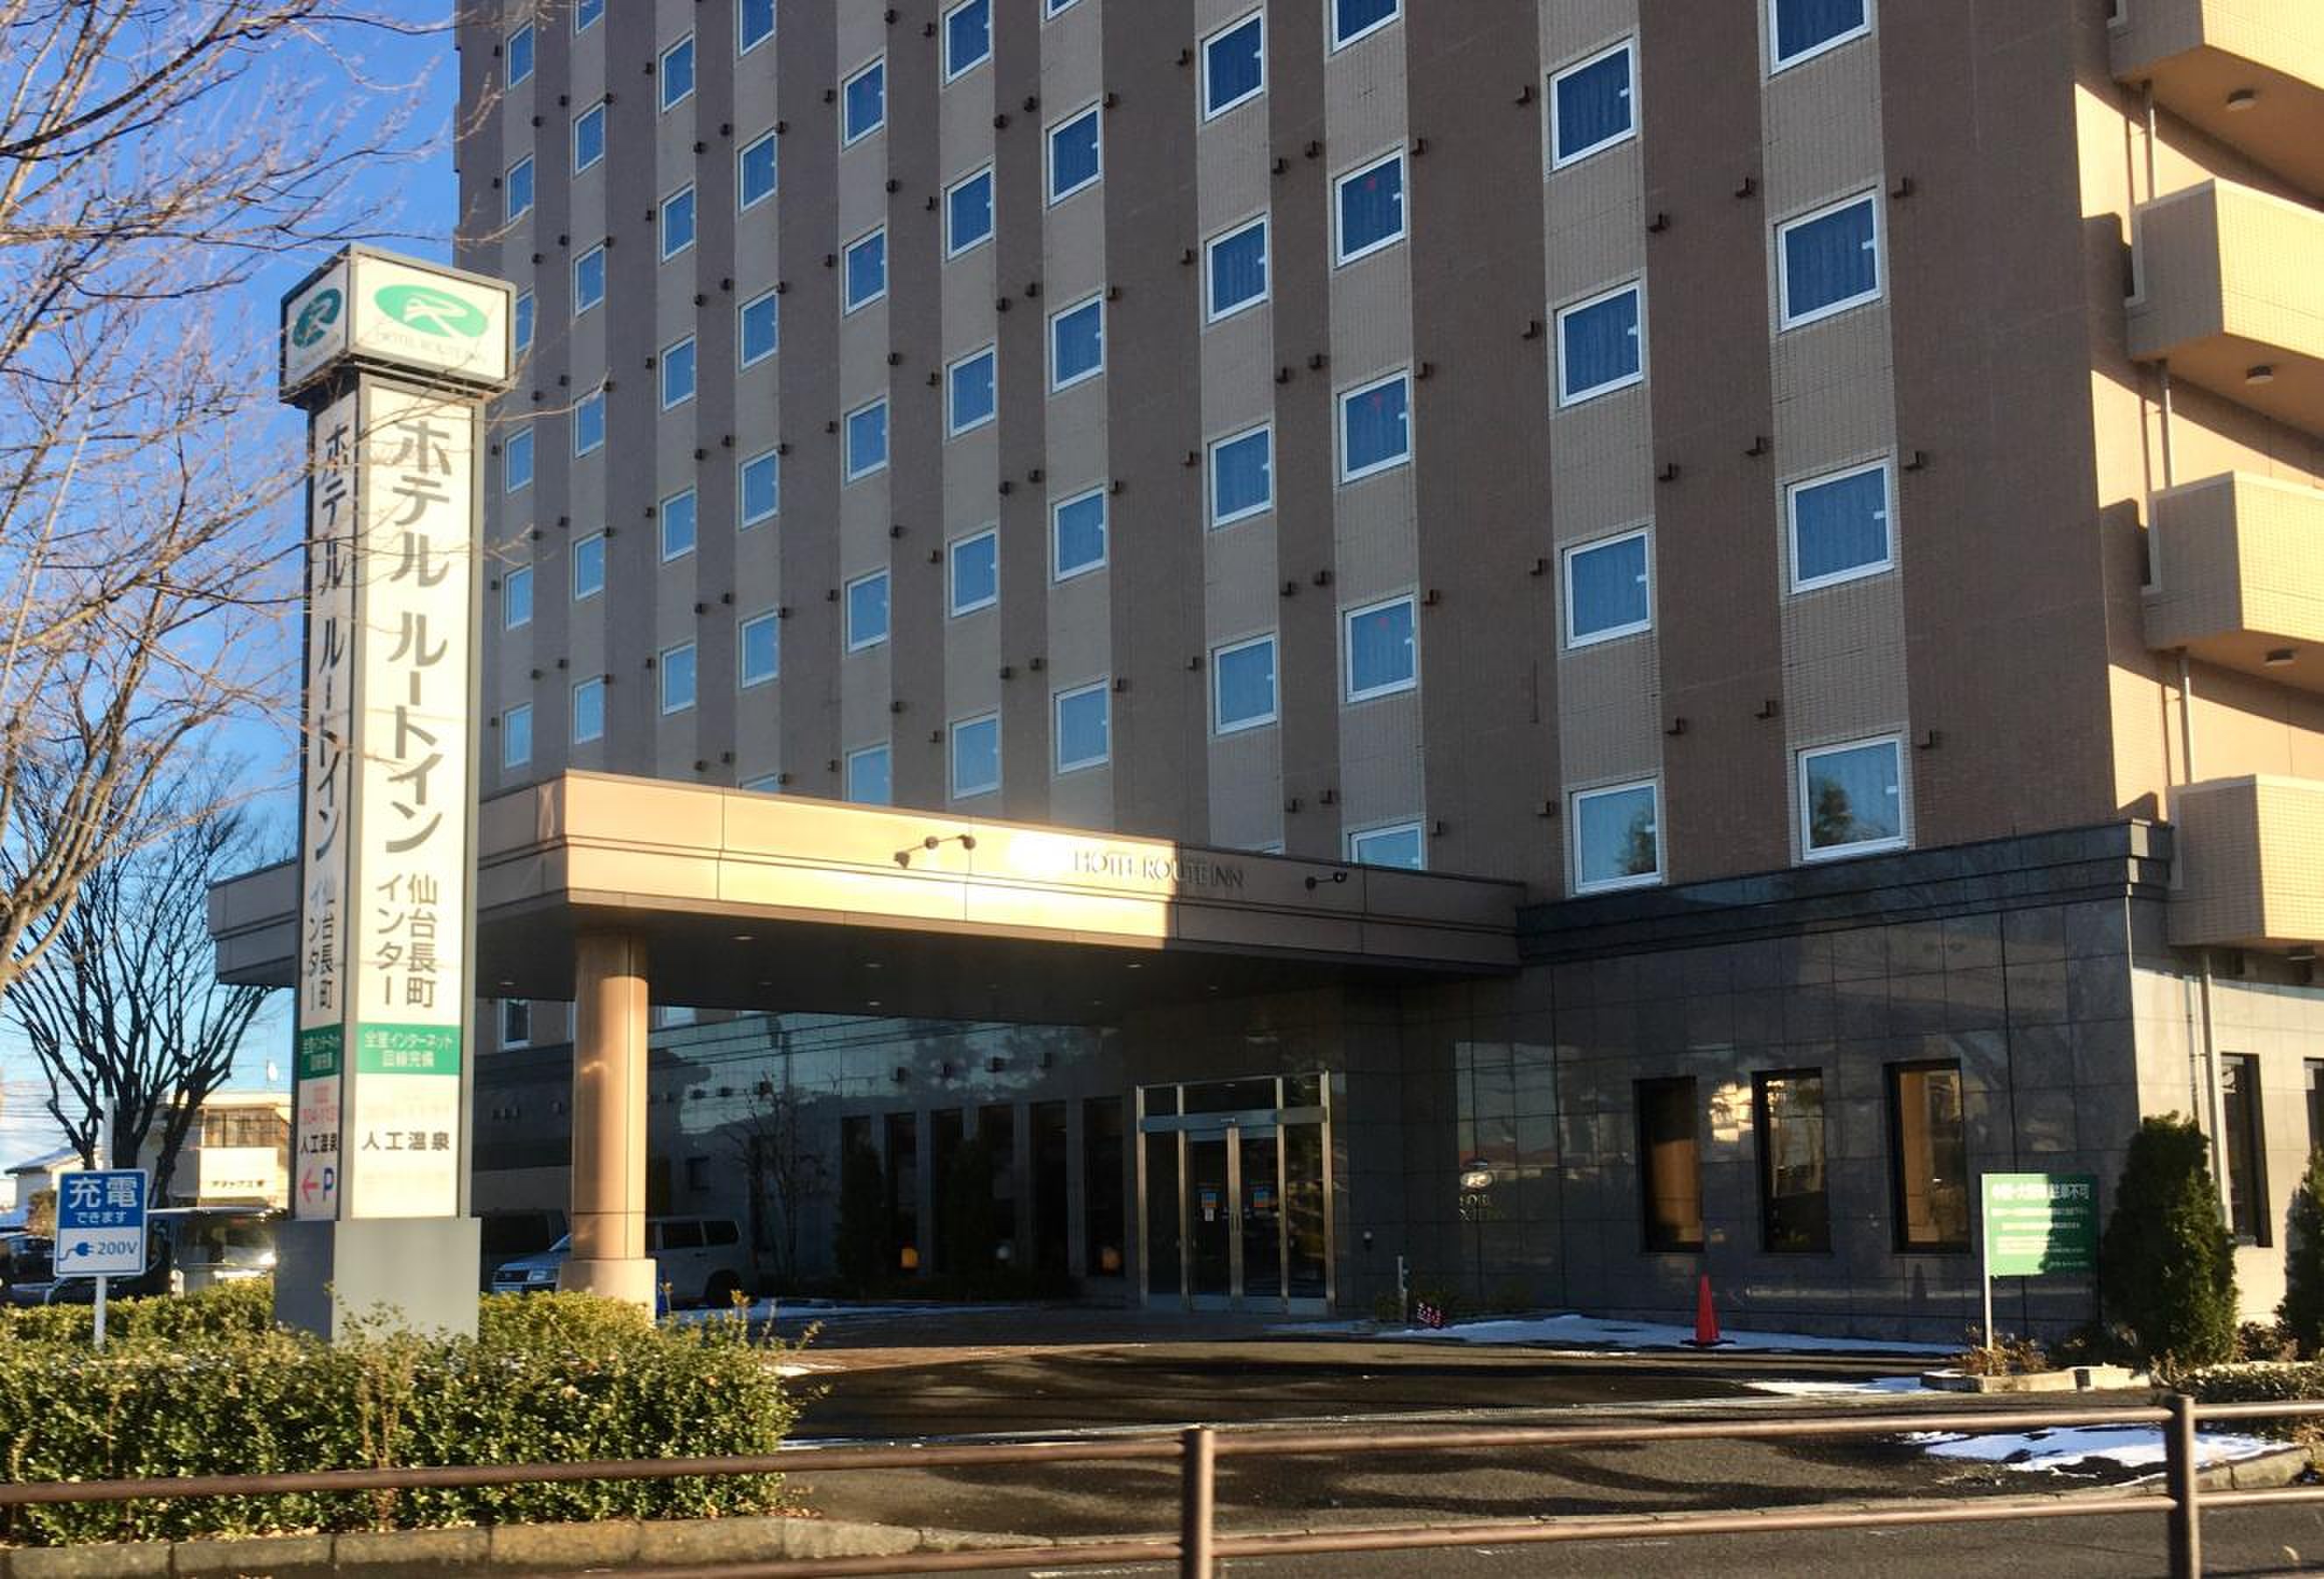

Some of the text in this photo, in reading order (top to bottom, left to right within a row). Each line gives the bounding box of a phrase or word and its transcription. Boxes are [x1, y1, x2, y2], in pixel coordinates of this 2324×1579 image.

[376, 874, 404, 1005] インター
[406, 874, 438, 1008] 仙台長町
[361, 1132, 450, 1151] 人工温泉
[68, 1177, 138, 1208] 充電
[322, 1168, 334, 1201] P
[75, 1211, 127, 1224] できます
[97, 1241, 139, 1255] 200V
